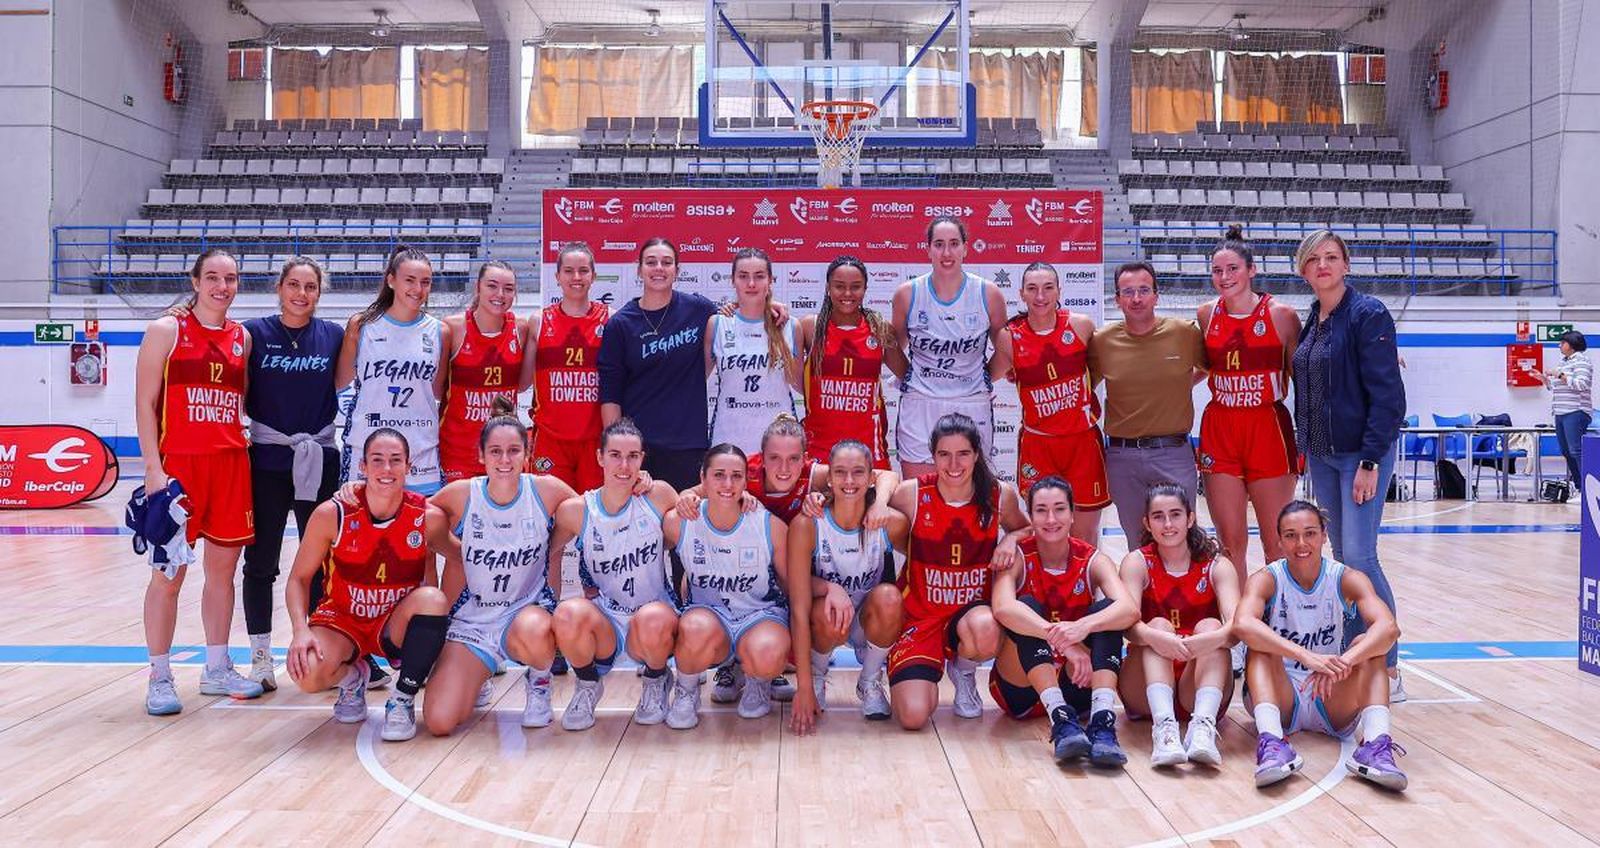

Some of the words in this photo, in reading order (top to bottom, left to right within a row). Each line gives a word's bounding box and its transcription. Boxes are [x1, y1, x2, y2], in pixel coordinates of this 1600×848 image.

[574, 201, 594, 209] FBM
[633, 202, 675, 212] molten
[872, 202, 915, 213] molten
[1045, 202, 1065, 210] FBM
[1016, 244, 1045, 253] TENKEY
[791, 300, 817, 309] TENKEY
[642, 326, 699, 359] LEGANÉS
[261, 353, 330, 373] LEGANÉS
[565, 347, 584, 367] 24
[842, 357, 854, 376] 11
[1226, 350, 1241, 370] 14
[209, 362, 224, 384] 12
[483, 365, 502, 386] 23
[744, 374, 762, 393] 18
[820, 379, 872, 397] VANTAGE
[1030, 376, 1081, 404] VANTAGE
[549, 386, 599, 402] TOWERS
[820, 395, 868, 413] TOWERS
[24, 481, 85, 494] iberCaja
[465, 543, 542, 572] LEGANÉS
[592, 540, 659, 577] LEGANÉS
[951, 543, 962, 566] 9
[375, 562, 387, 584] 4
[925, 567, 988, 587] VANTAGE
[492, 574, 512, 593] 11
[691, 574, 759, 594] LEGANÉS
[926, 586, 984, 605] TOWERS
